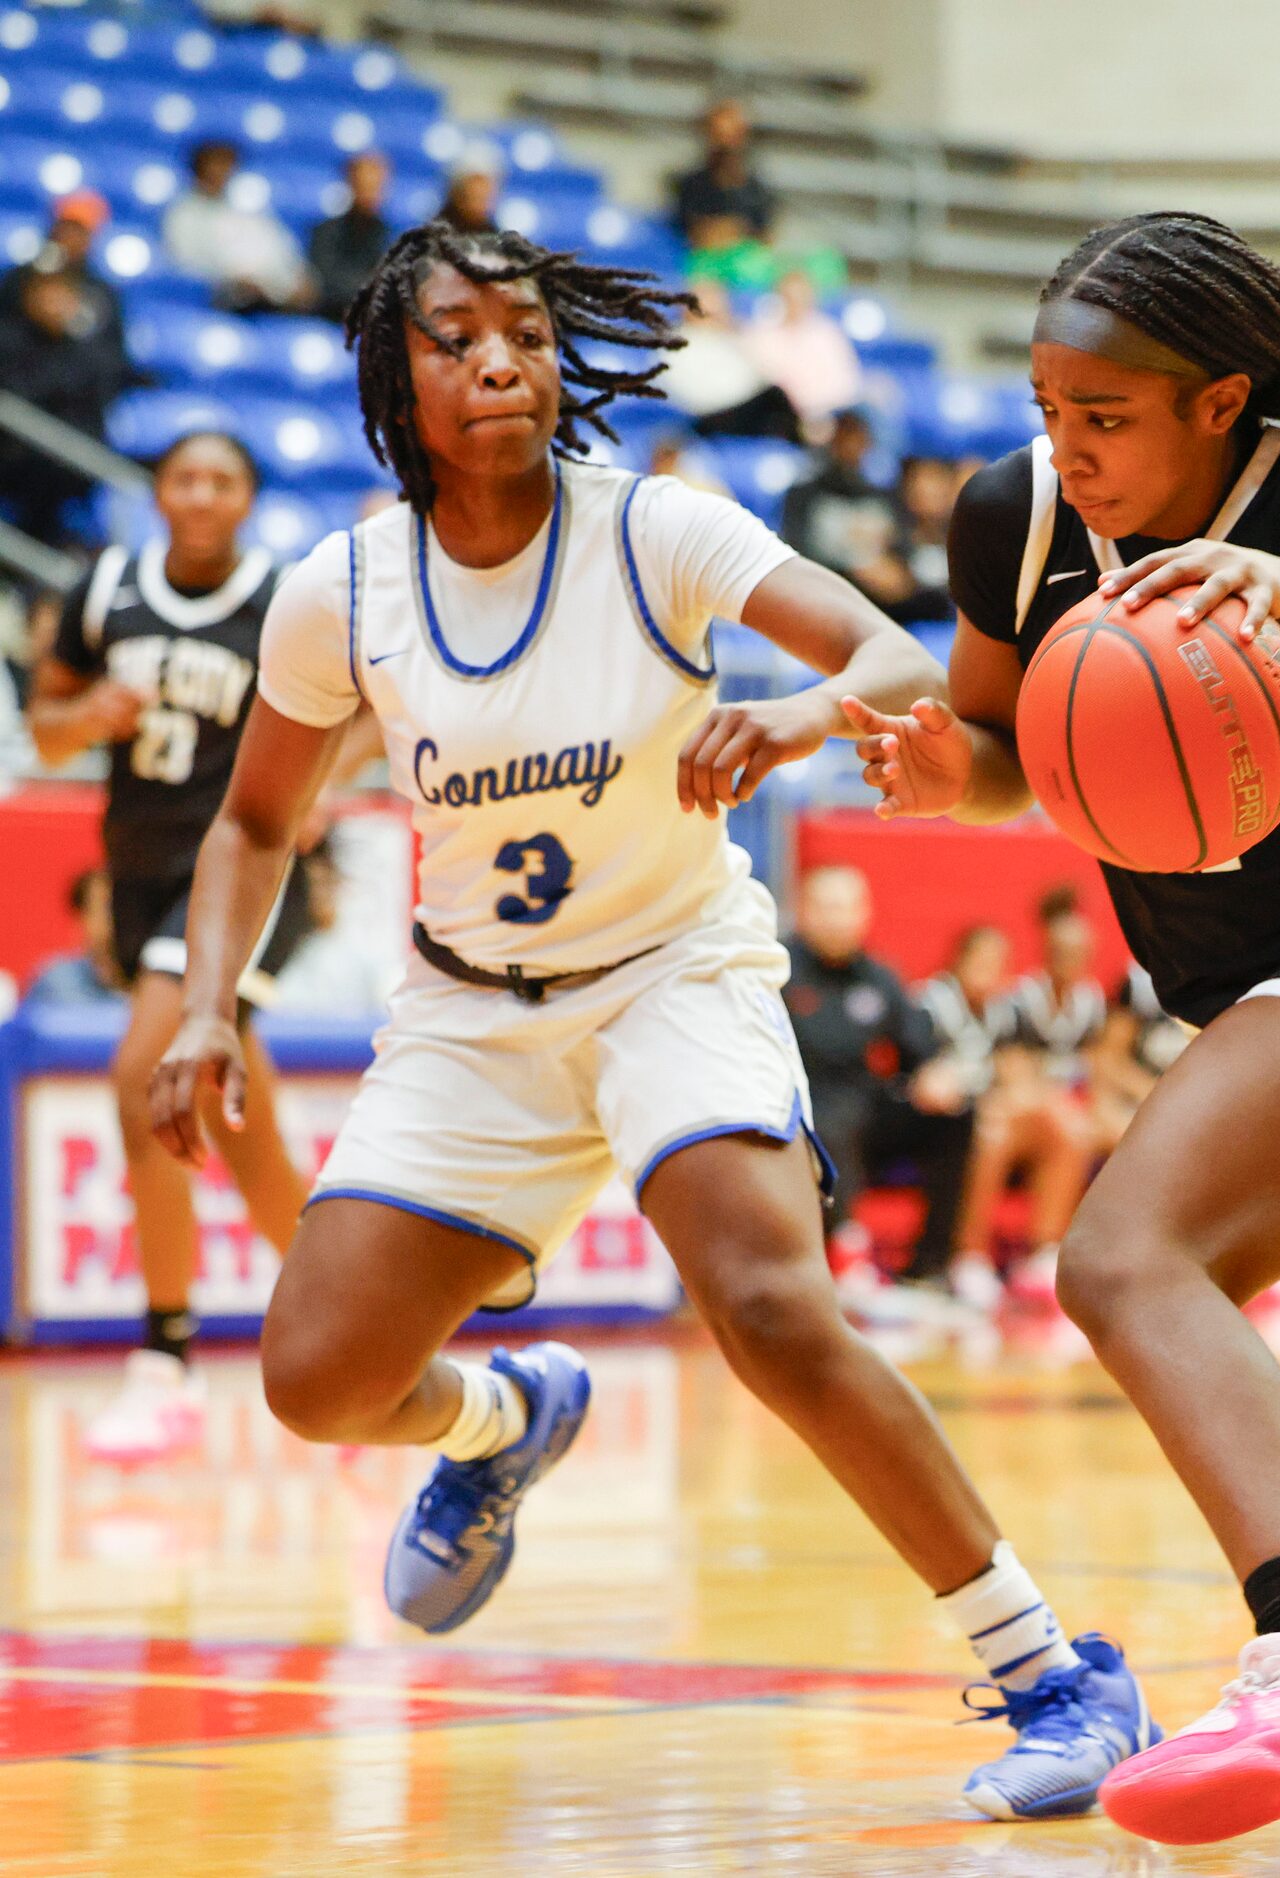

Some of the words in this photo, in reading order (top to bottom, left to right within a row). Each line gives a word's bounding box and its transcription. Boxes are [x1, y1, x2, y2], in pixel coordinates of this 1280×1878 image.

[414, 737, 624, 808] Conway
[1237, 785, 1260, 834] PRO
[494, 832, 575, 924] 3
